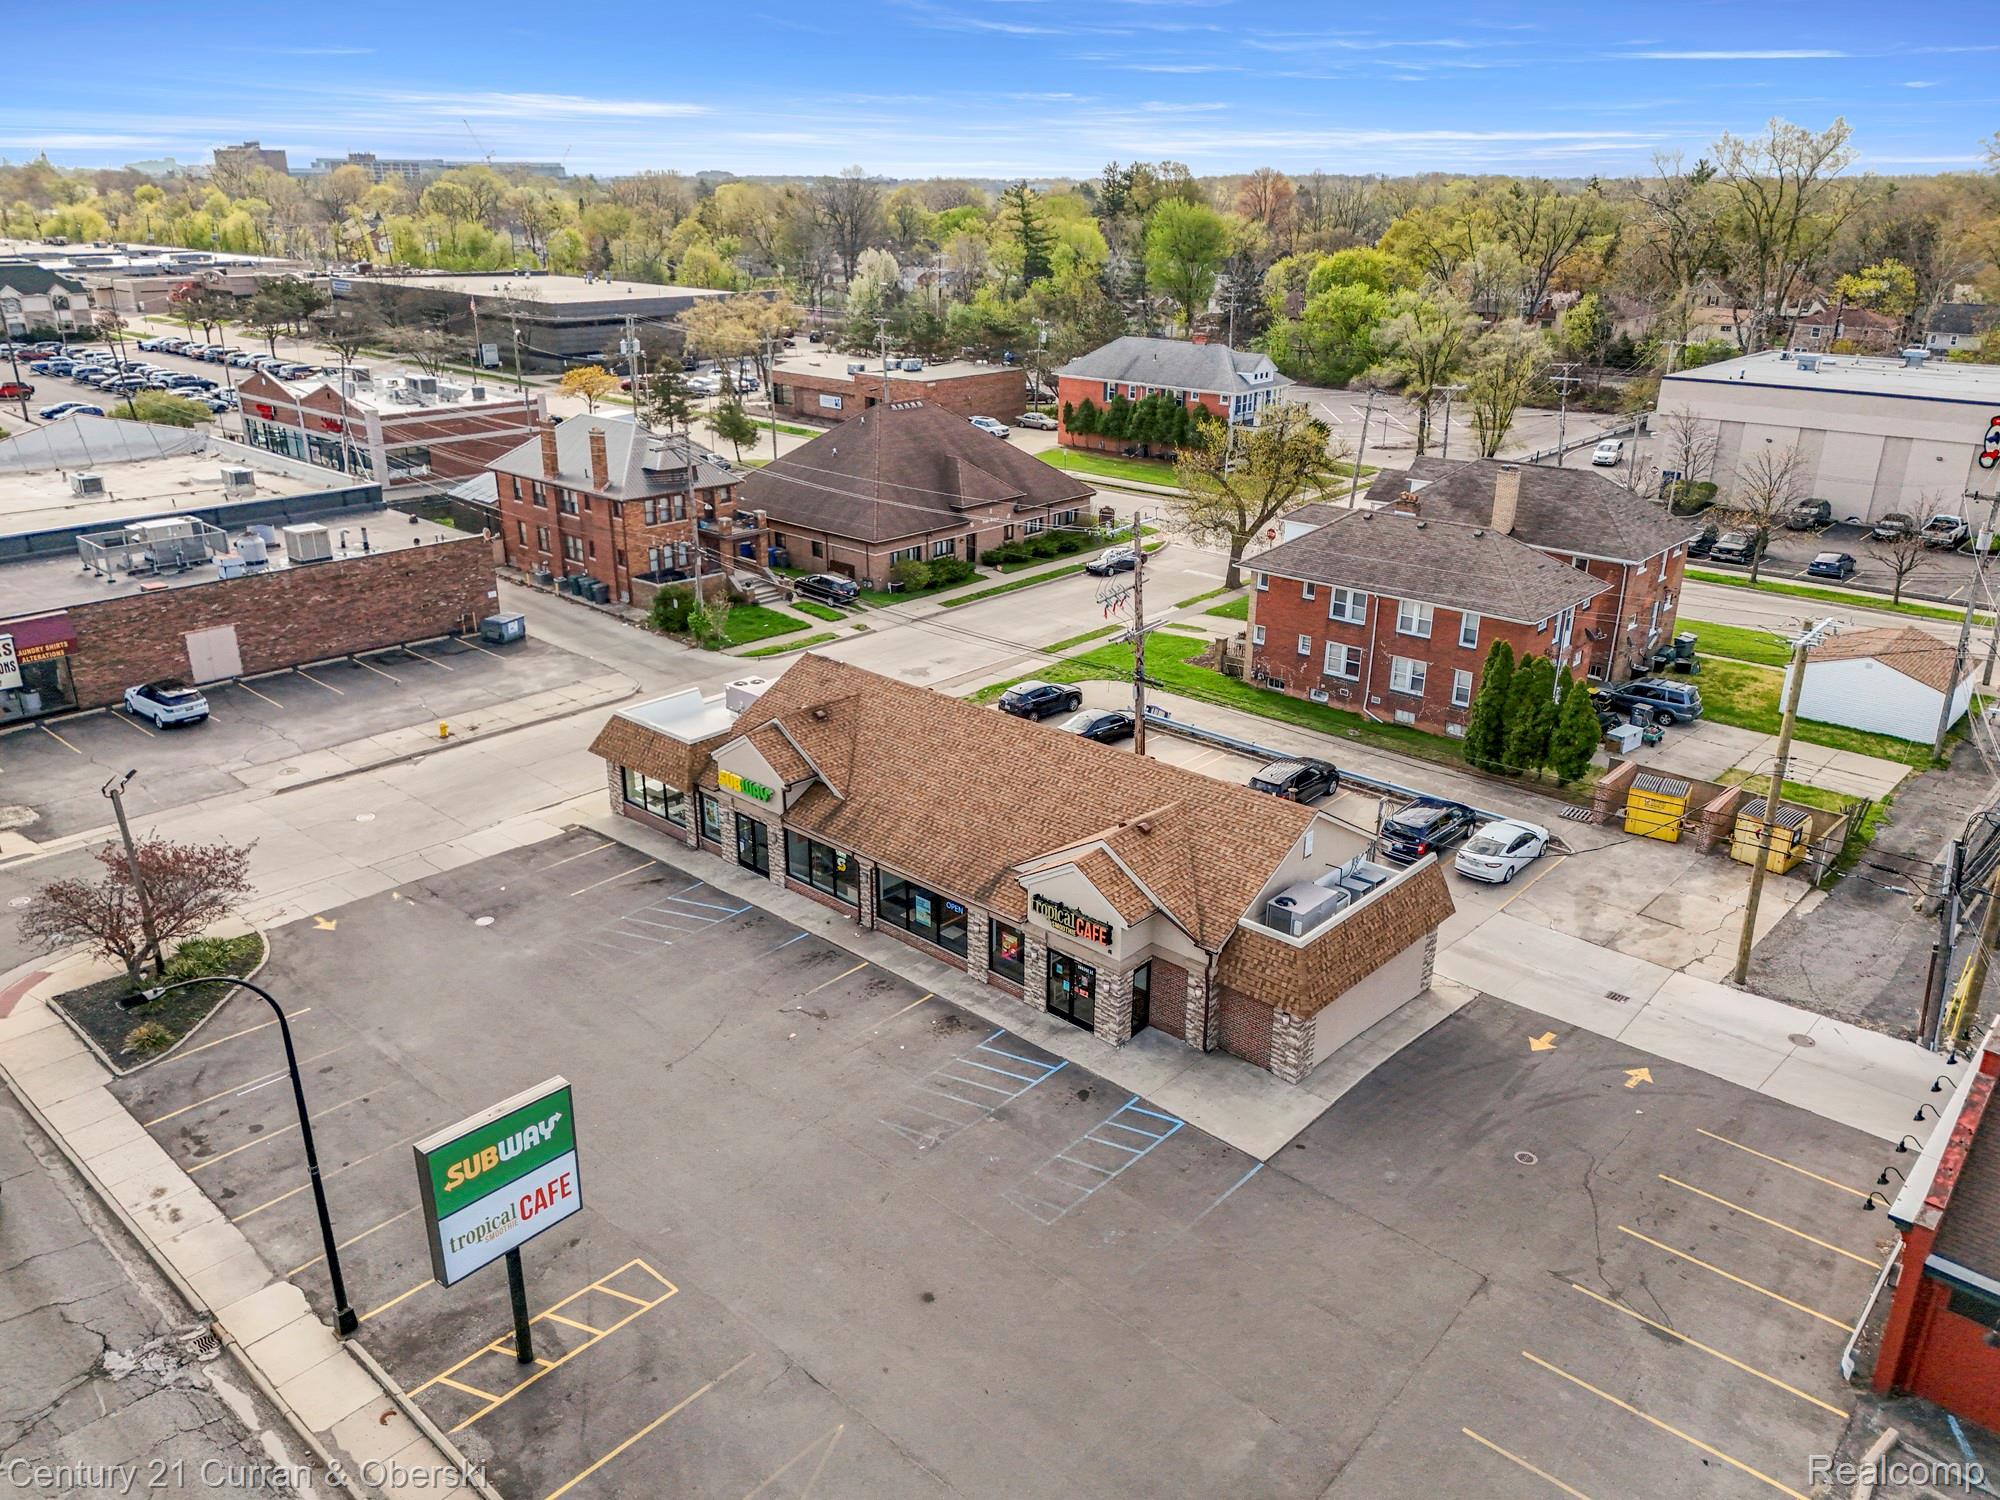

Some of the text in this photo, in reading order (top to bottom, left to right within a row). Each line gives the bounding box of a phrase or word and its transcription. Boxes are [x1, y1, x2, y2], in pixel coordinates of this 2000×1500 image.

[22, 649, 65, 663] ALTERATIONS
[45, 641, 69, 651] SHIRTS
[718, 769, 774, 802] SUBWAY
[946, 901, 964, 915] OPEN
[1051, 921, 1076, 937] SMOOTHIE
[1076, 918, 1107, 947] CAFE
[444, 1112, 562, 1192] SUBWAY
[449, 1172, 572, 1253] tropical CAFE
[484, 1221, 519, 1243] SMOOTHIE
